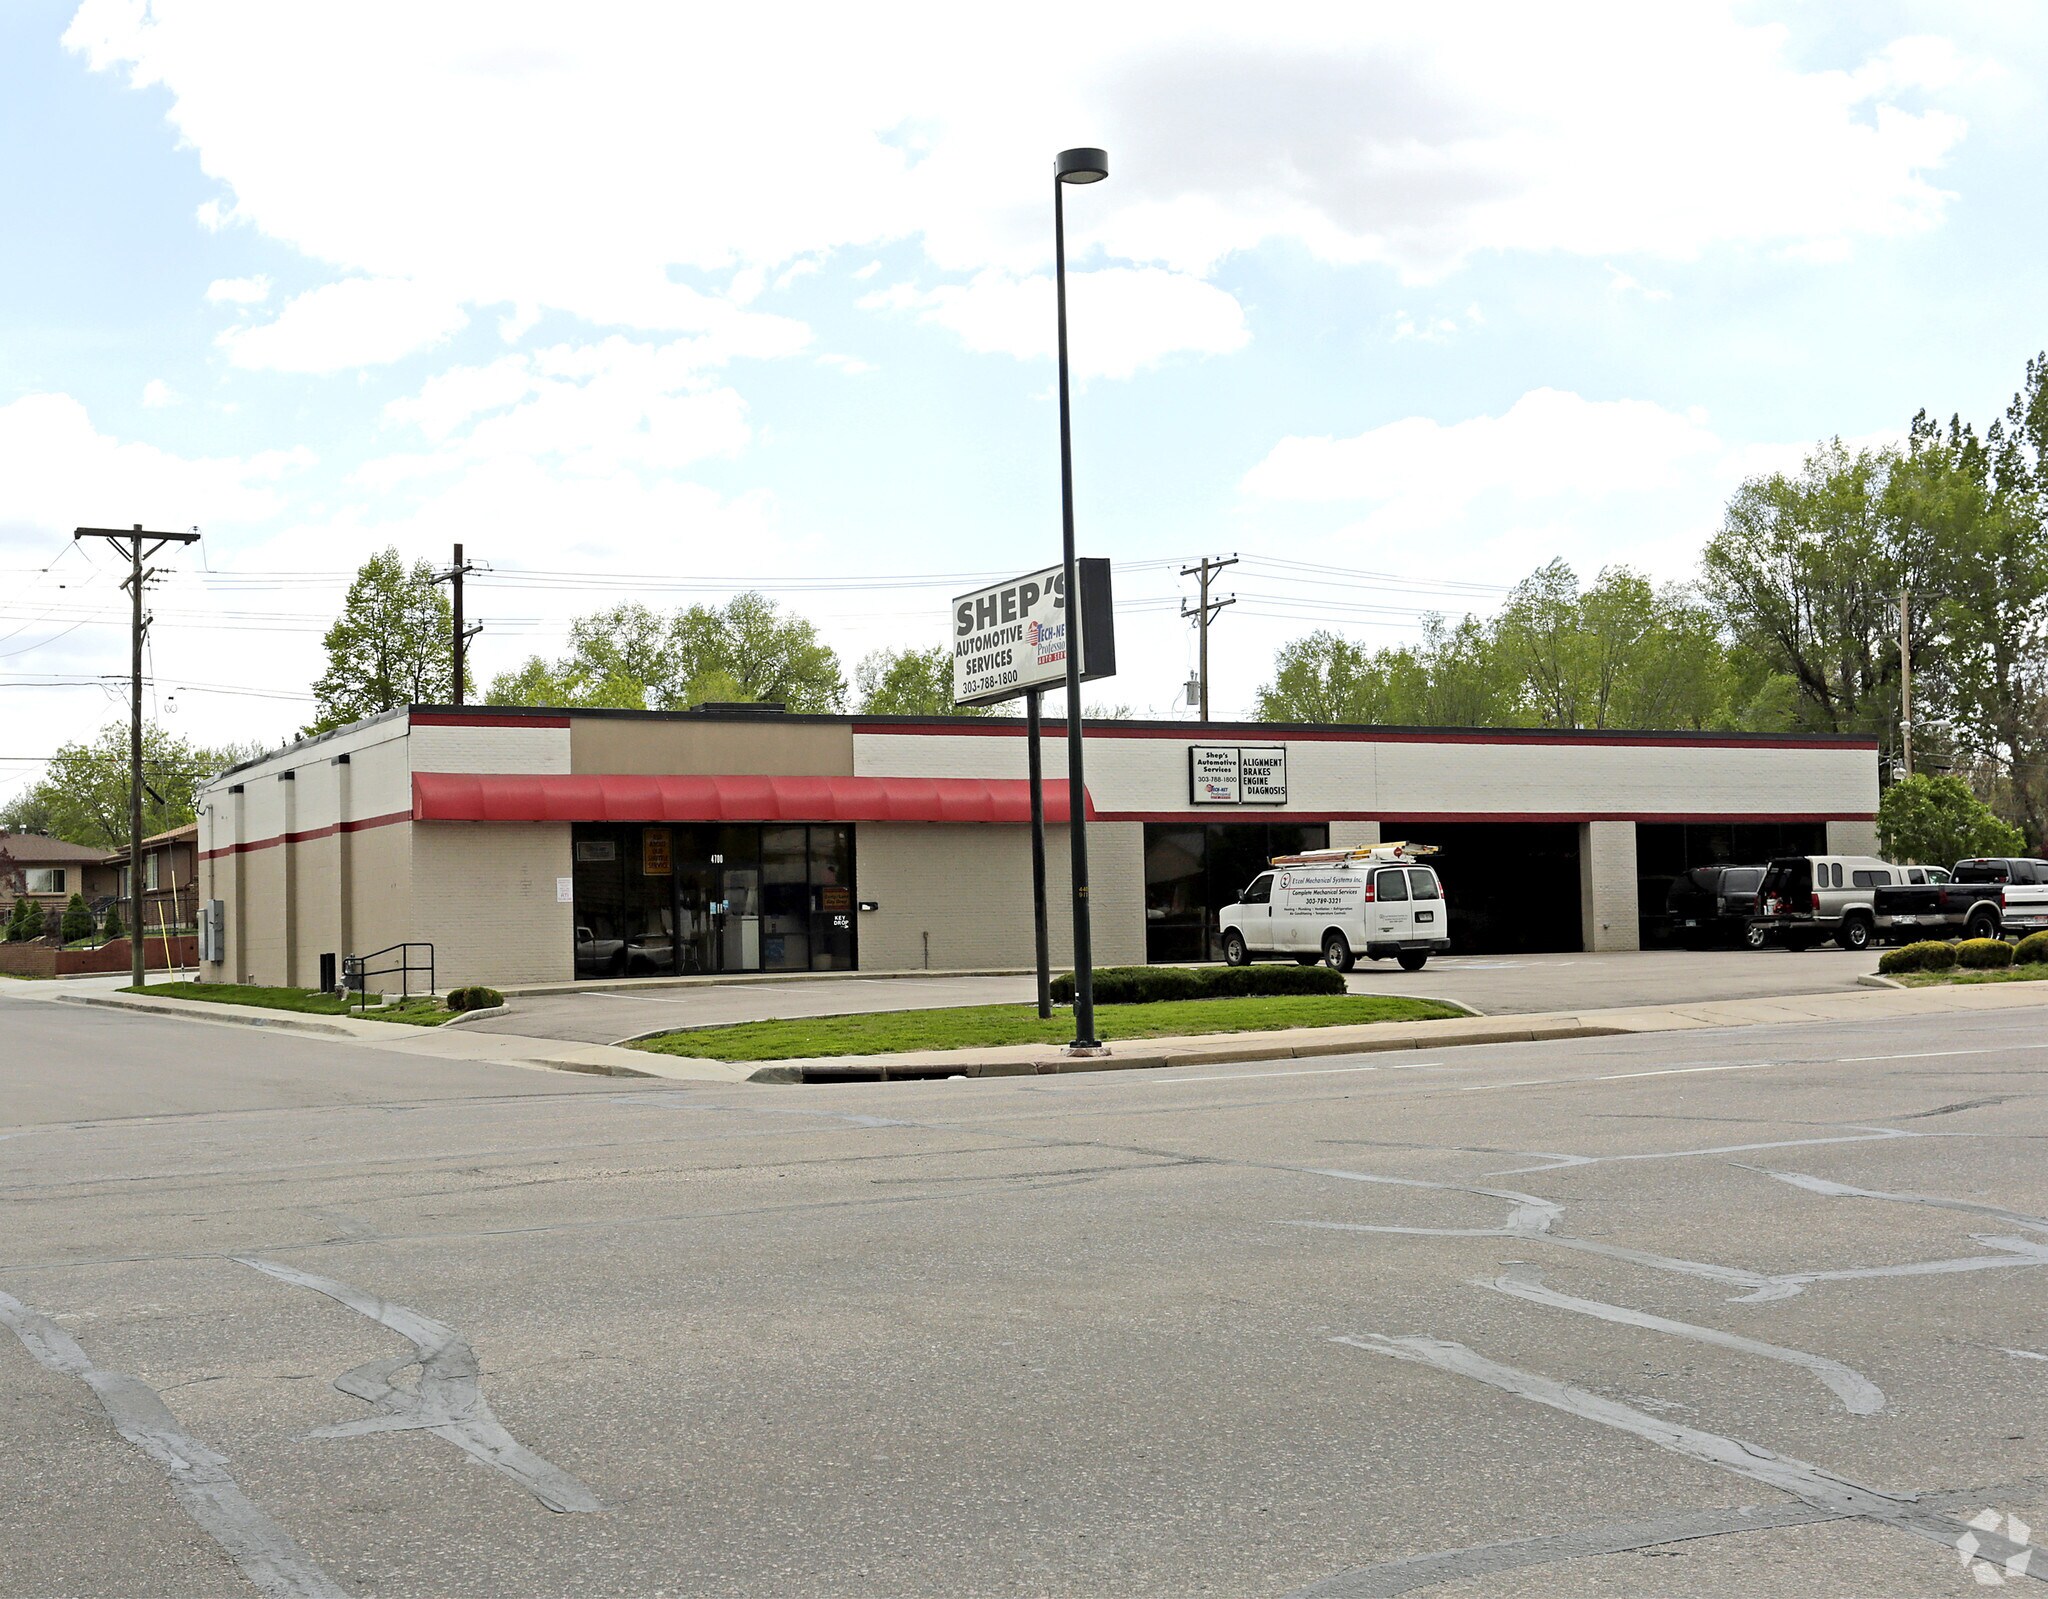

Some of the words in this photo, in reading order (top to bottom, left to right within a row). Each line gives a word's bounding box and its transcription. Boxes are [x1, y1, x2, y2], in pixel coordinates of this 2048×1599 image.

[1037, 623, 1065, 643] TECH-NE
[956, 624, 1023, 658] AUTOMOTIVE
[1038, 638, 1066, 656] Professio
[966, 649, 1013, 676] SERVICES
[1038, 655, 1053, 665] AUTO
[963, 669, 1018, 695] 303-788-1800
[1206, 752, 1228, 760] Shep's
[1243, 758, 1282, 767] ALIGNMENT
[1243, 768, 1271, 776] BRAKES
[1243, 777, 1268, 785] ENGINE
[1248, 786, 1285, 795] DIAGNOSIS
[710, 854, 724, 864] 4700
[1332, 876, 1352, 884] Systems
